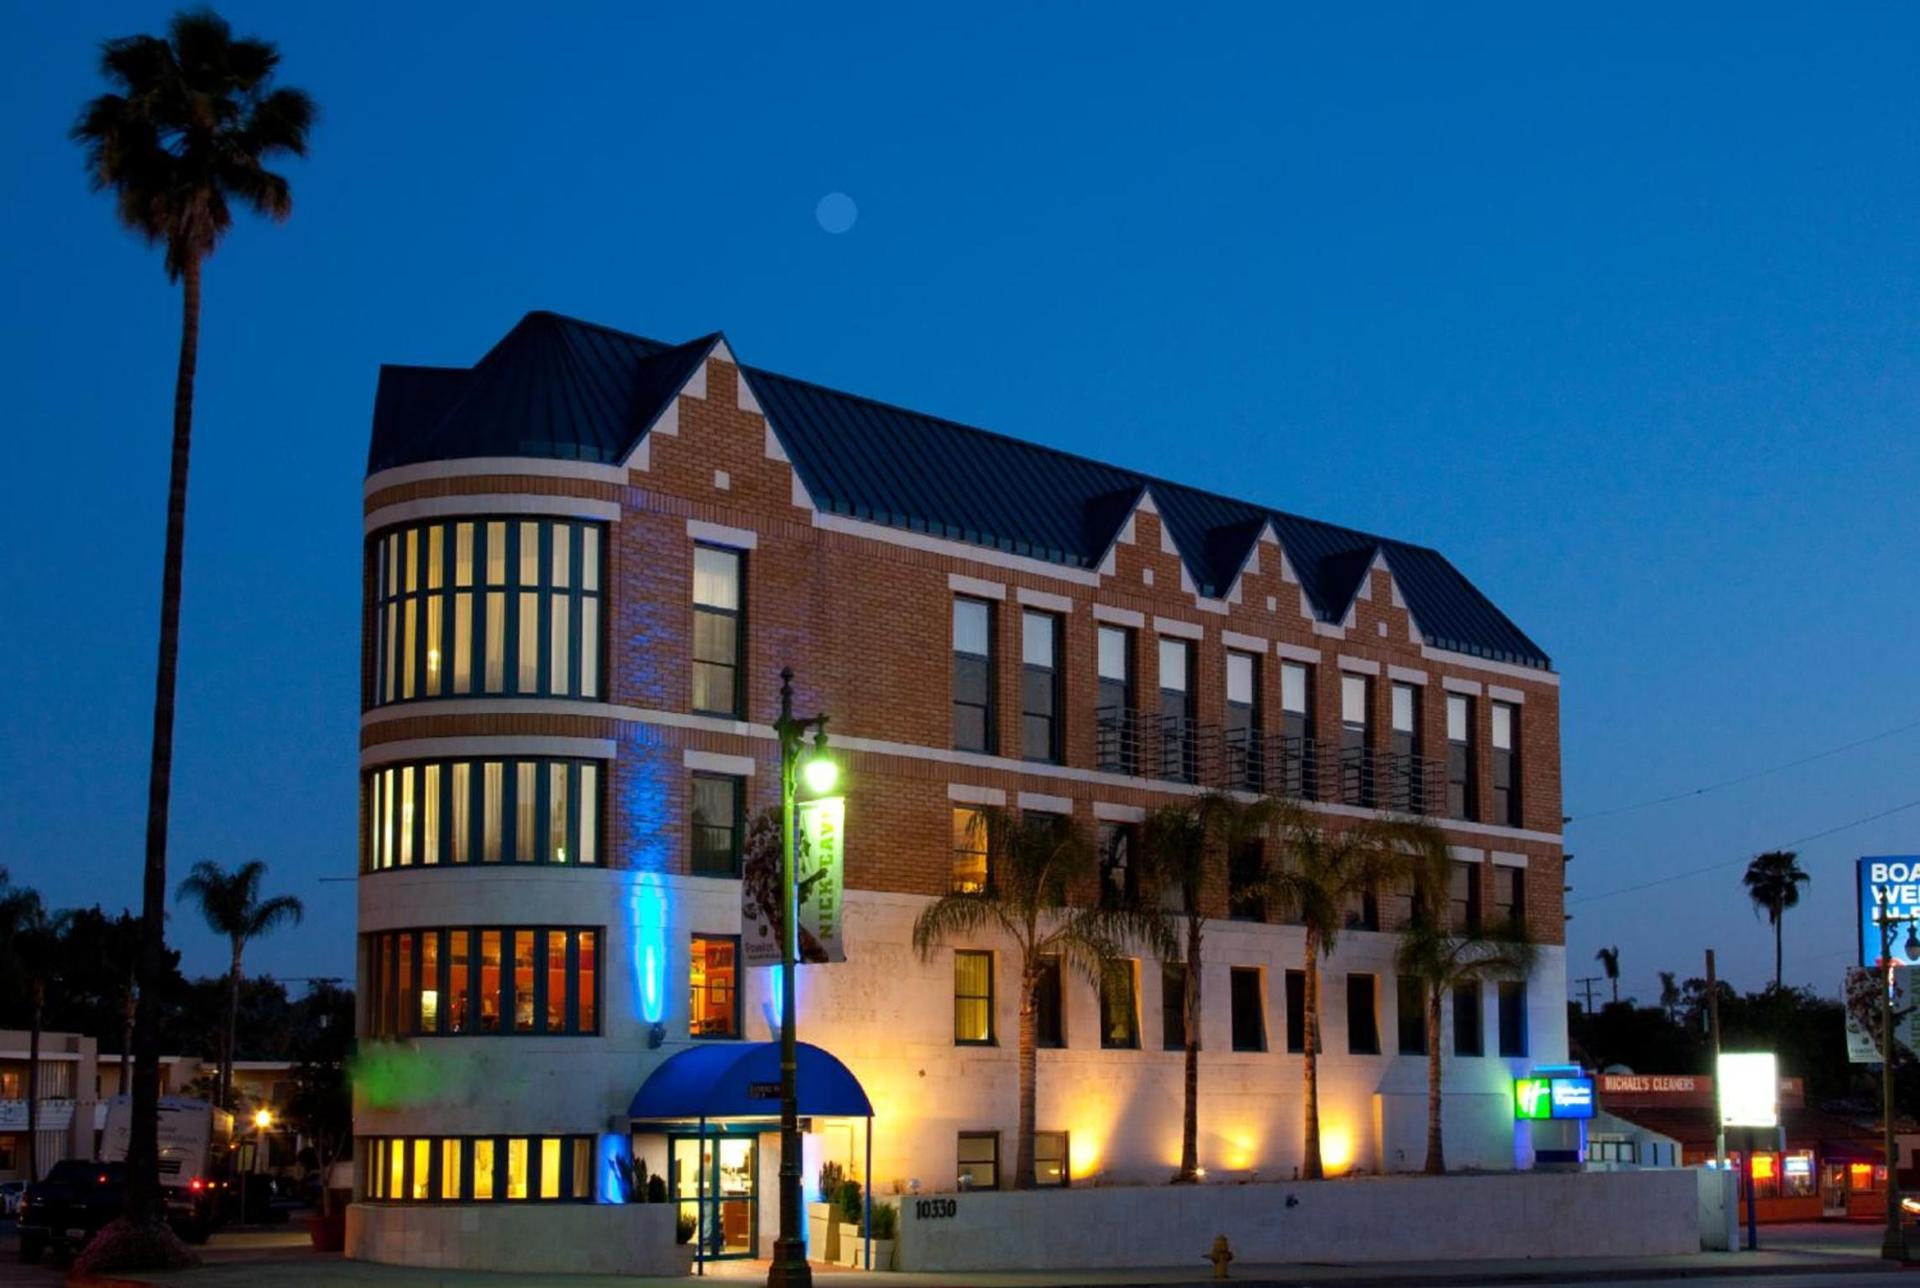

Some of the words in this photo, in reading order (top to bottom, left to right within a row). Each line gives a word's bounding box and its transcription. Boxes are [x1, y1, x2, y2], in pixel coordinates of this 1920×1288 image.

[1870, 885, 1920, 904] WE
[819, 877, 833, 939] NICK
[915, 1199, 957, 1220] 10330
